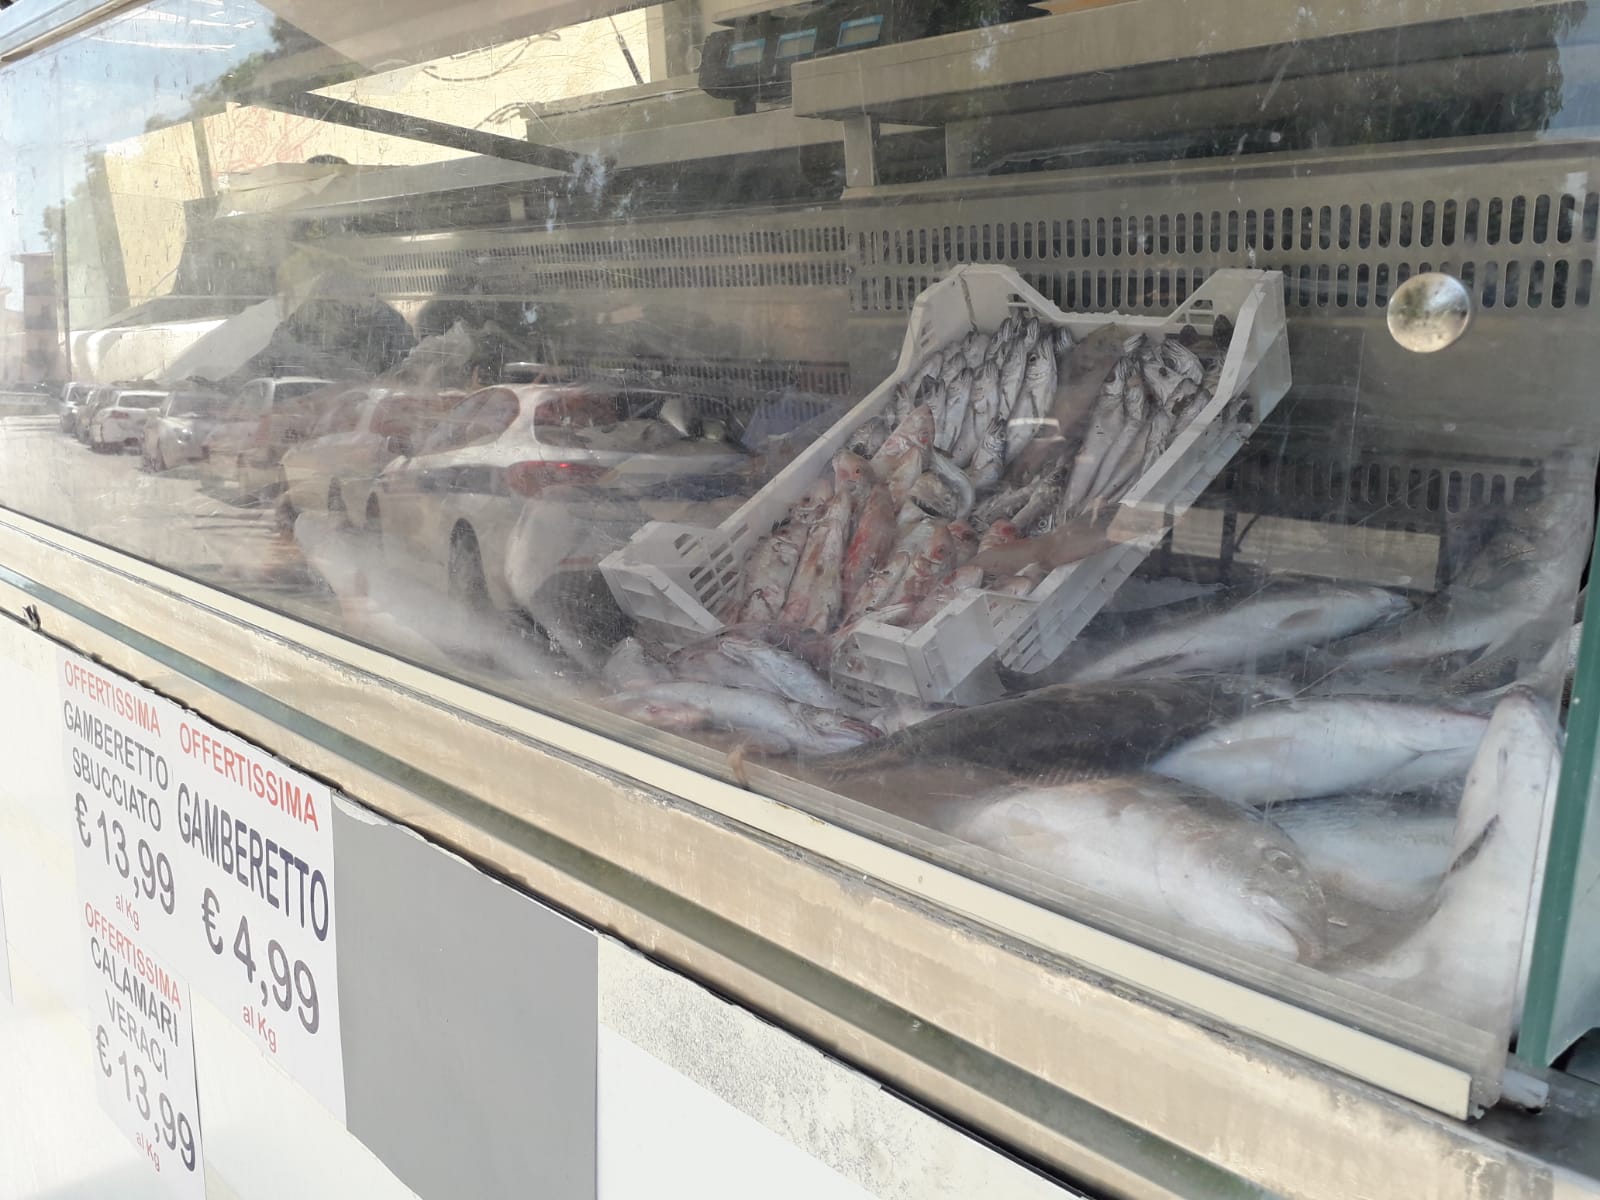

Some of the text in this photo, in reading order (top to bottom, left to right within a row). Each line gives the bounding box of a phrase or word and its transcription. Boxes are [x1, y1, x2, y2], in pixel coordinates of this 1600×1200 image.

[64, 660, 161, 737] OFFERTISSIMA
[64, 700, 169, 791] GAMBERETTO
[73, 747, 162, 832] SBUCCIATO
[179, 723, 319, 832] OFFERTISSIMA
[75, 792, 175, 915] € 13,99
[178, 783, 329, 941] GAMBERETTO
[85, 902, 181, 1010] OFFERTISSIMA
[115, 895, 140, 931] al Kg
[201, 888, 320, 1034] € 4,99
[90, 937, 178, 1047] CALAMARI
[105, 988, 168, 1080] VERACI
[243, 1005, 277, 1053] al Kg
[96, 1024, 196, 1172] € 13,99
